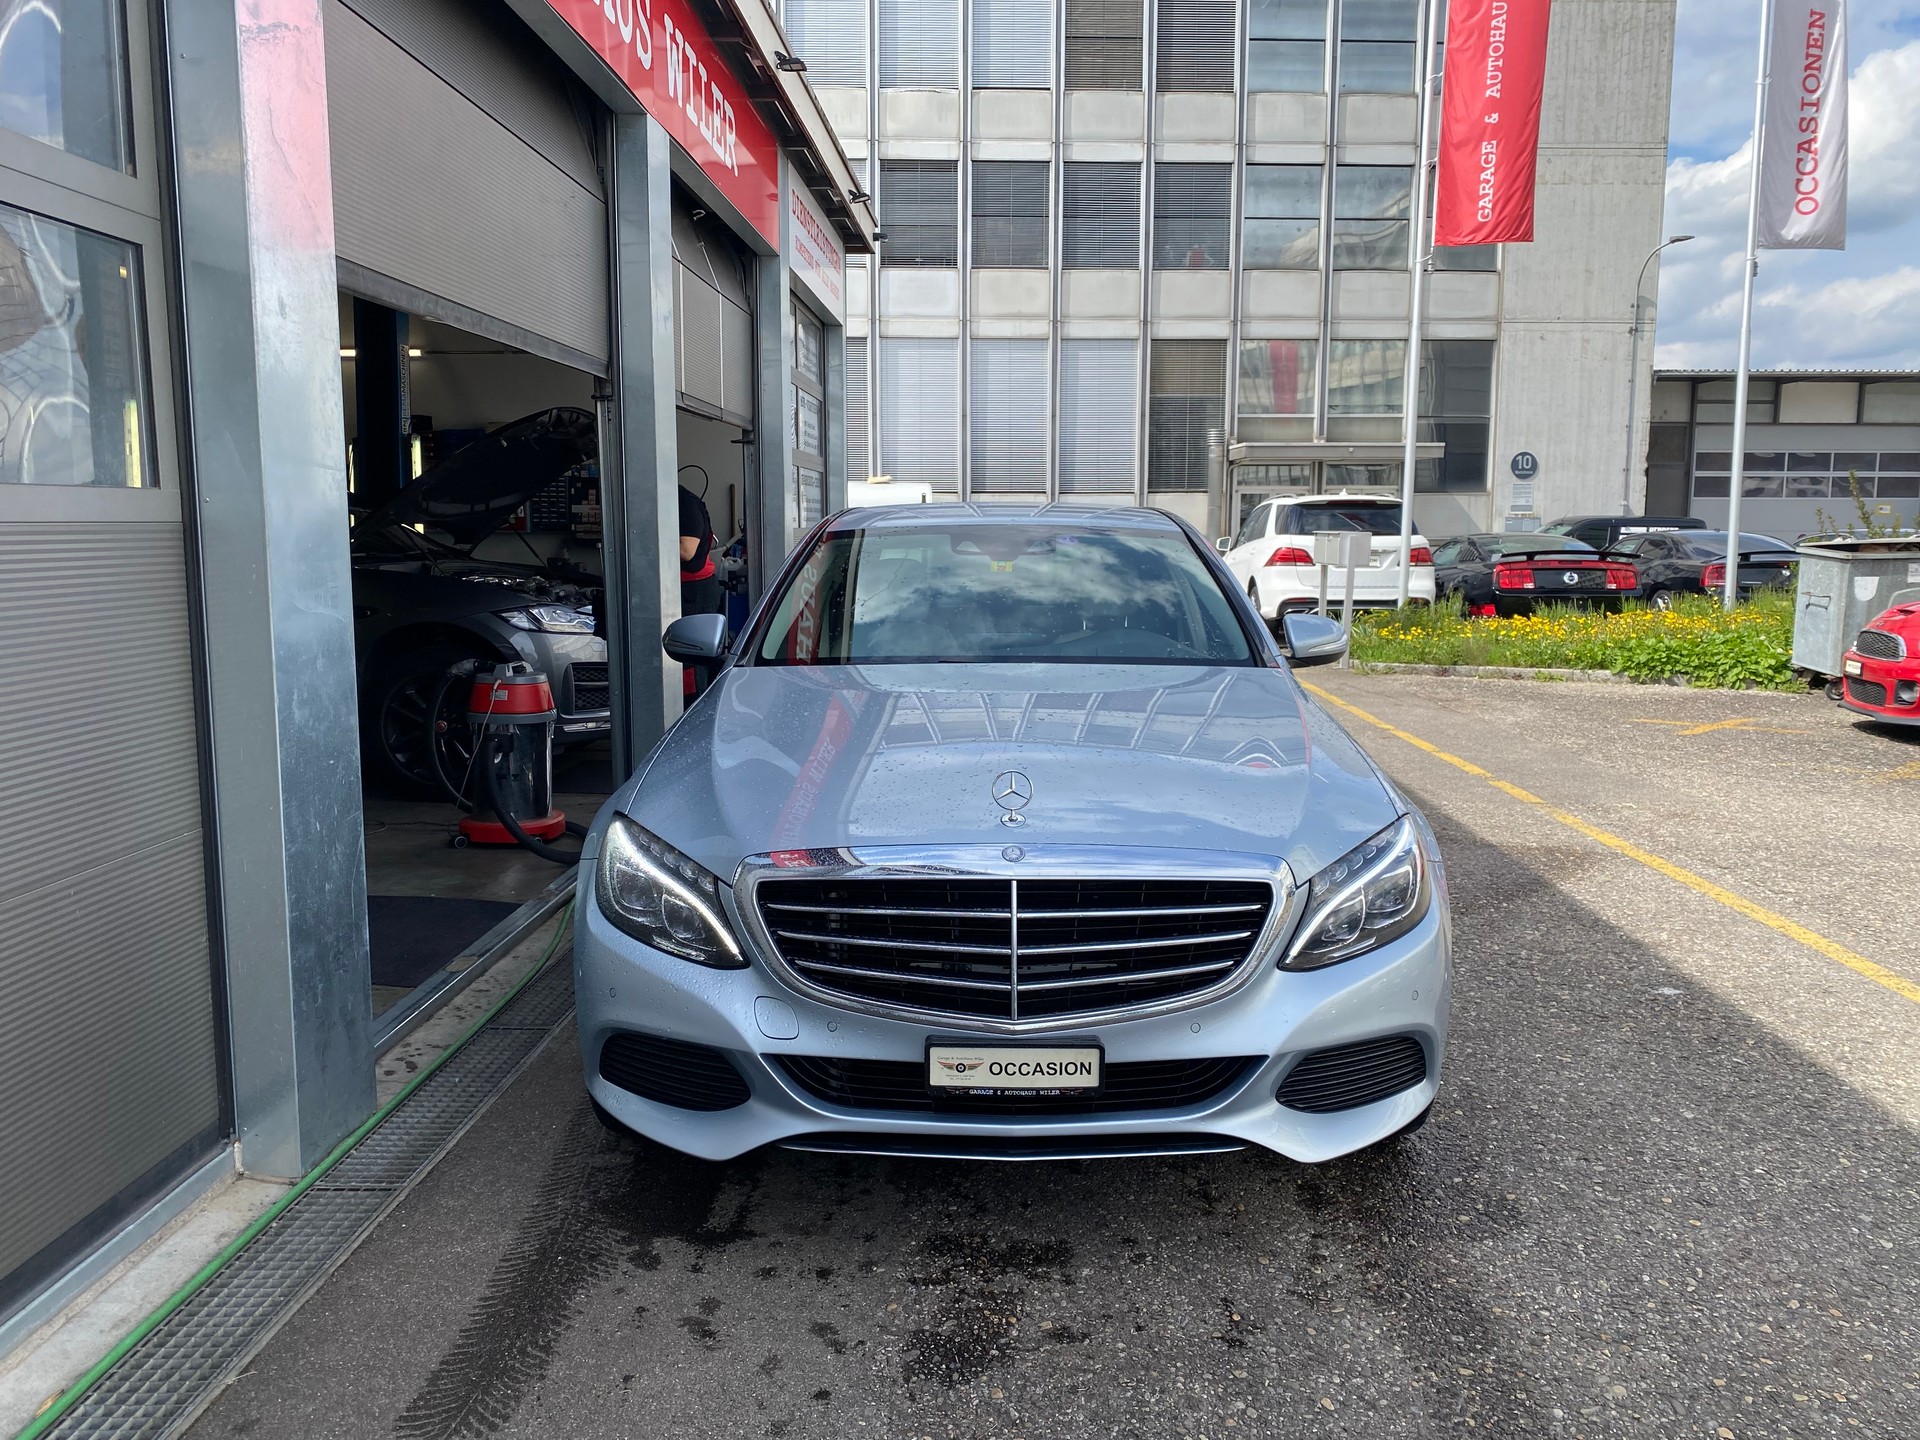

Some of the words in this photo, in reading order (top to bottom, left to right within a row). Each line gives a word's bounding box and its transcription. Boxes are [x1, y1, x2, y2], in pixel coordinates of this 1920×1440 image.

[1486, 1, 1508, 98] AUTOHAU
[663, 13, 739, 177] WILER
[1485, 112, 1499, 124] &
[1794, 8, 1826, 216] OCCASIONEN
[1478, 140, 1497, 222] GARAGE
[1516, 455, 1532, 469] 10
[989, 1062, 1092, 1076] OCCASION
